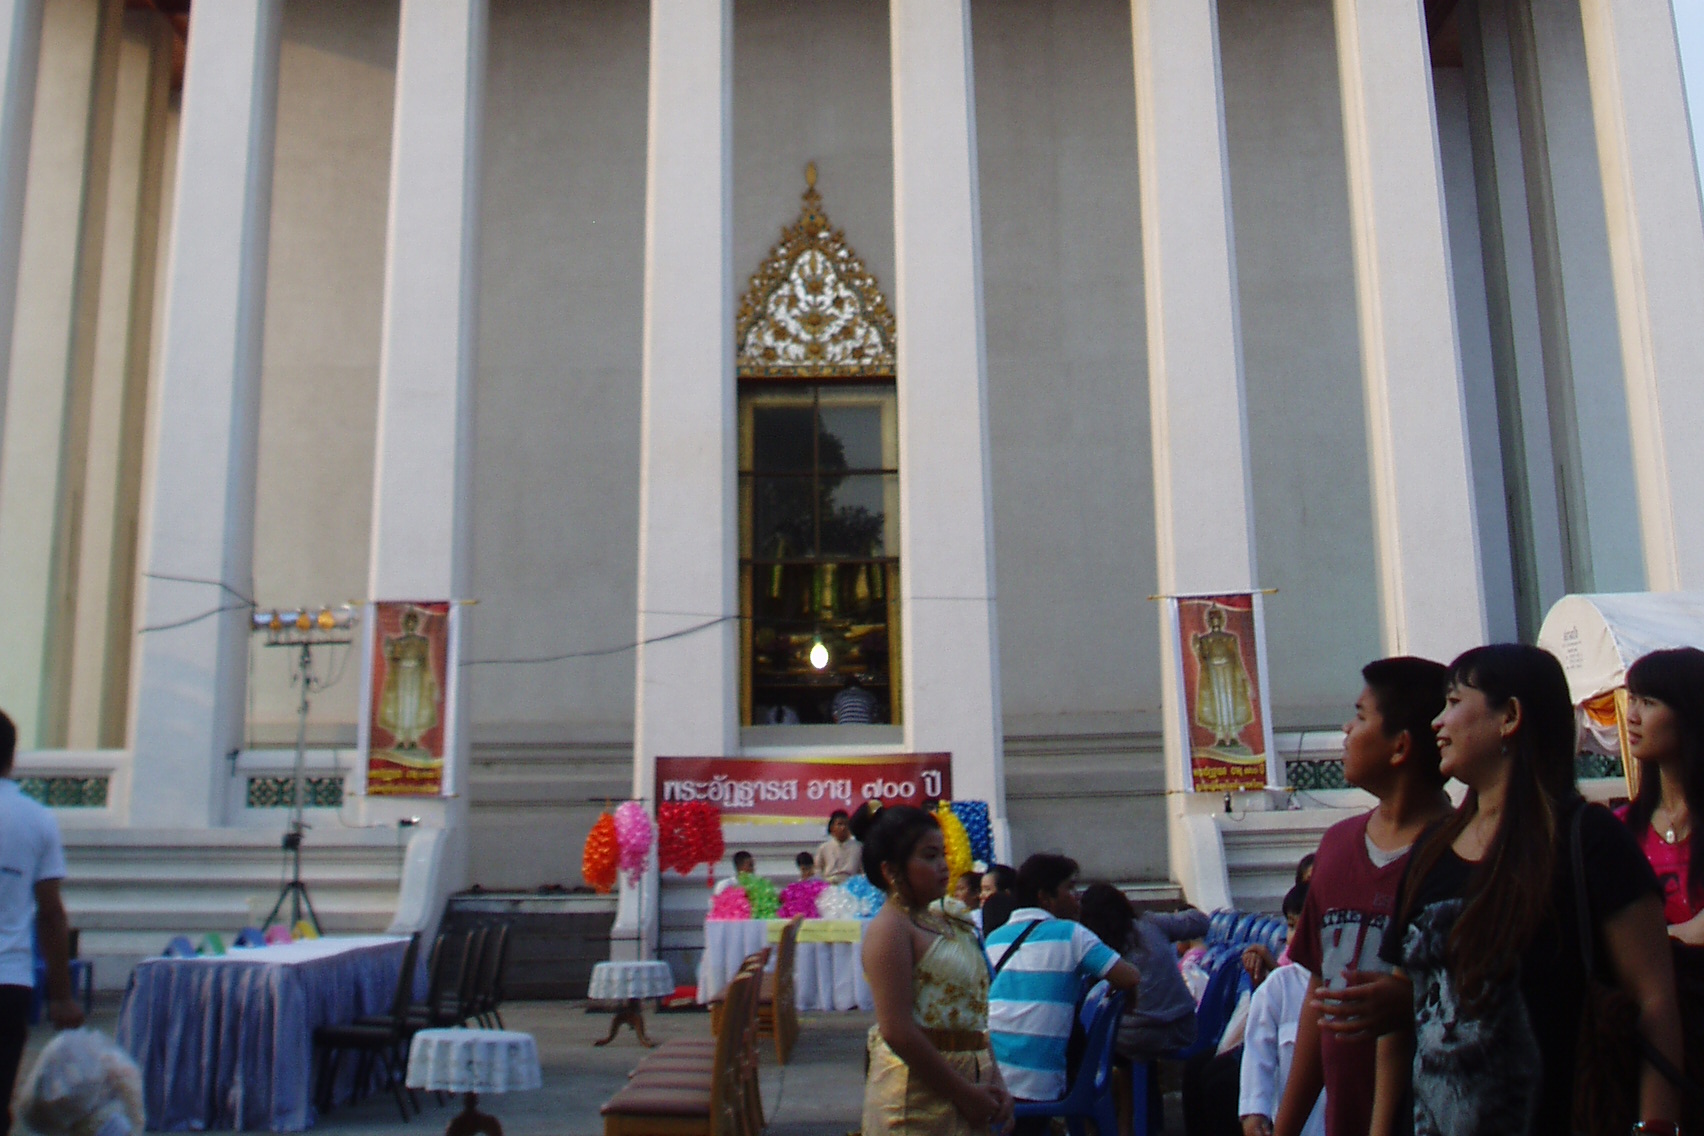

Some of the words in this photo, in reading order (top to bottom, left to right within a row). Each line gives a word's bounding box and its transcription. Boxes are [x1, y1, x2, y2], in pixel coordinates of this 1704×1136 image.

[807, 779, 852, 806] อายุ
[861, 778, 916, 799] ๗๐๐
[921, 769, 942, 797] ปี
